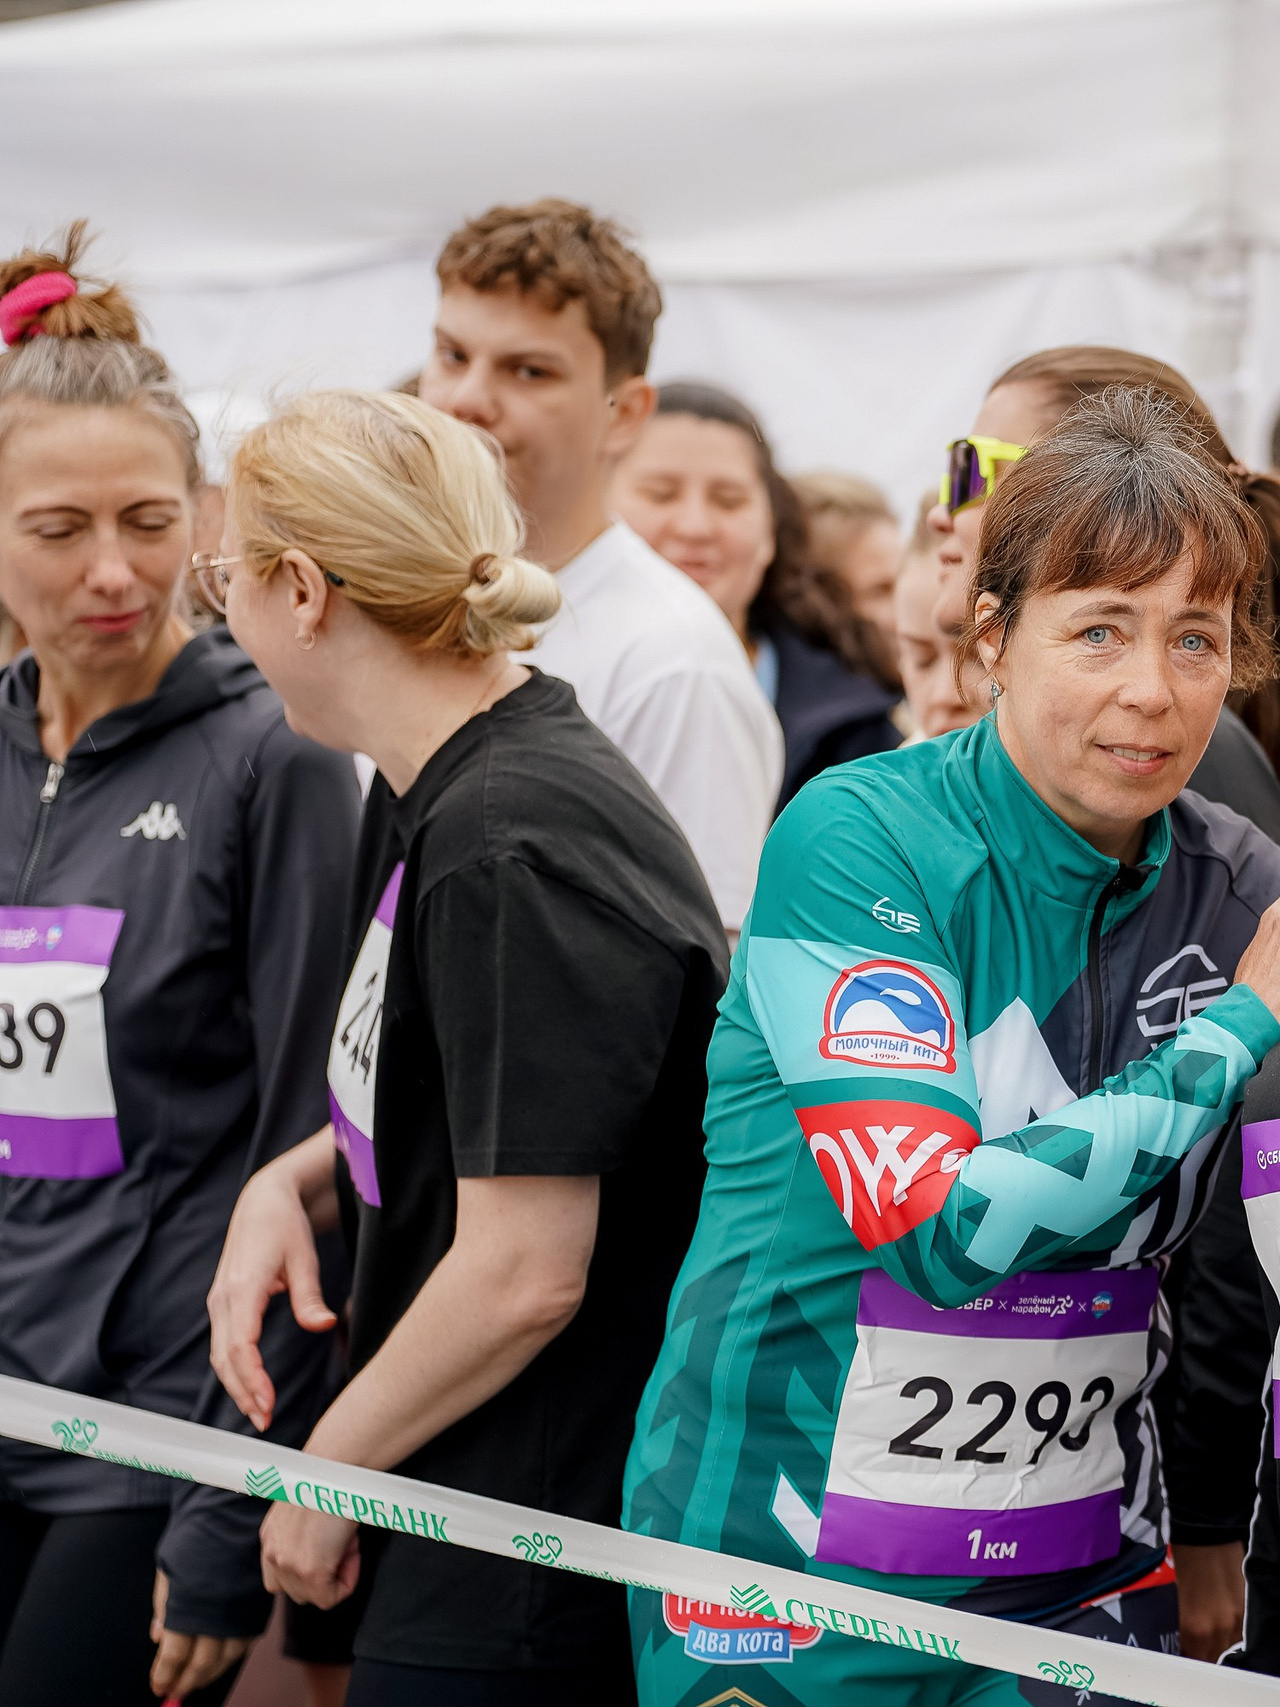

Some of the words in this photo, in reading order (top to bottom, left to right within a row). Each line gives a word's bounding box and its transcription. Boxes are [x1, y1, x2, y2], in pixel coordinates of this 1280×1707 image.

[836, 1037, 909, 1053] МОЛОЧНЫЙ
[913, 1045, 940, 1061] КИТ
[956, 1298, 994, 1311] БЕР
[1018, 1295, 1055, 1305] зелёный
[1011, 1304, 1051, 1315] марафон
